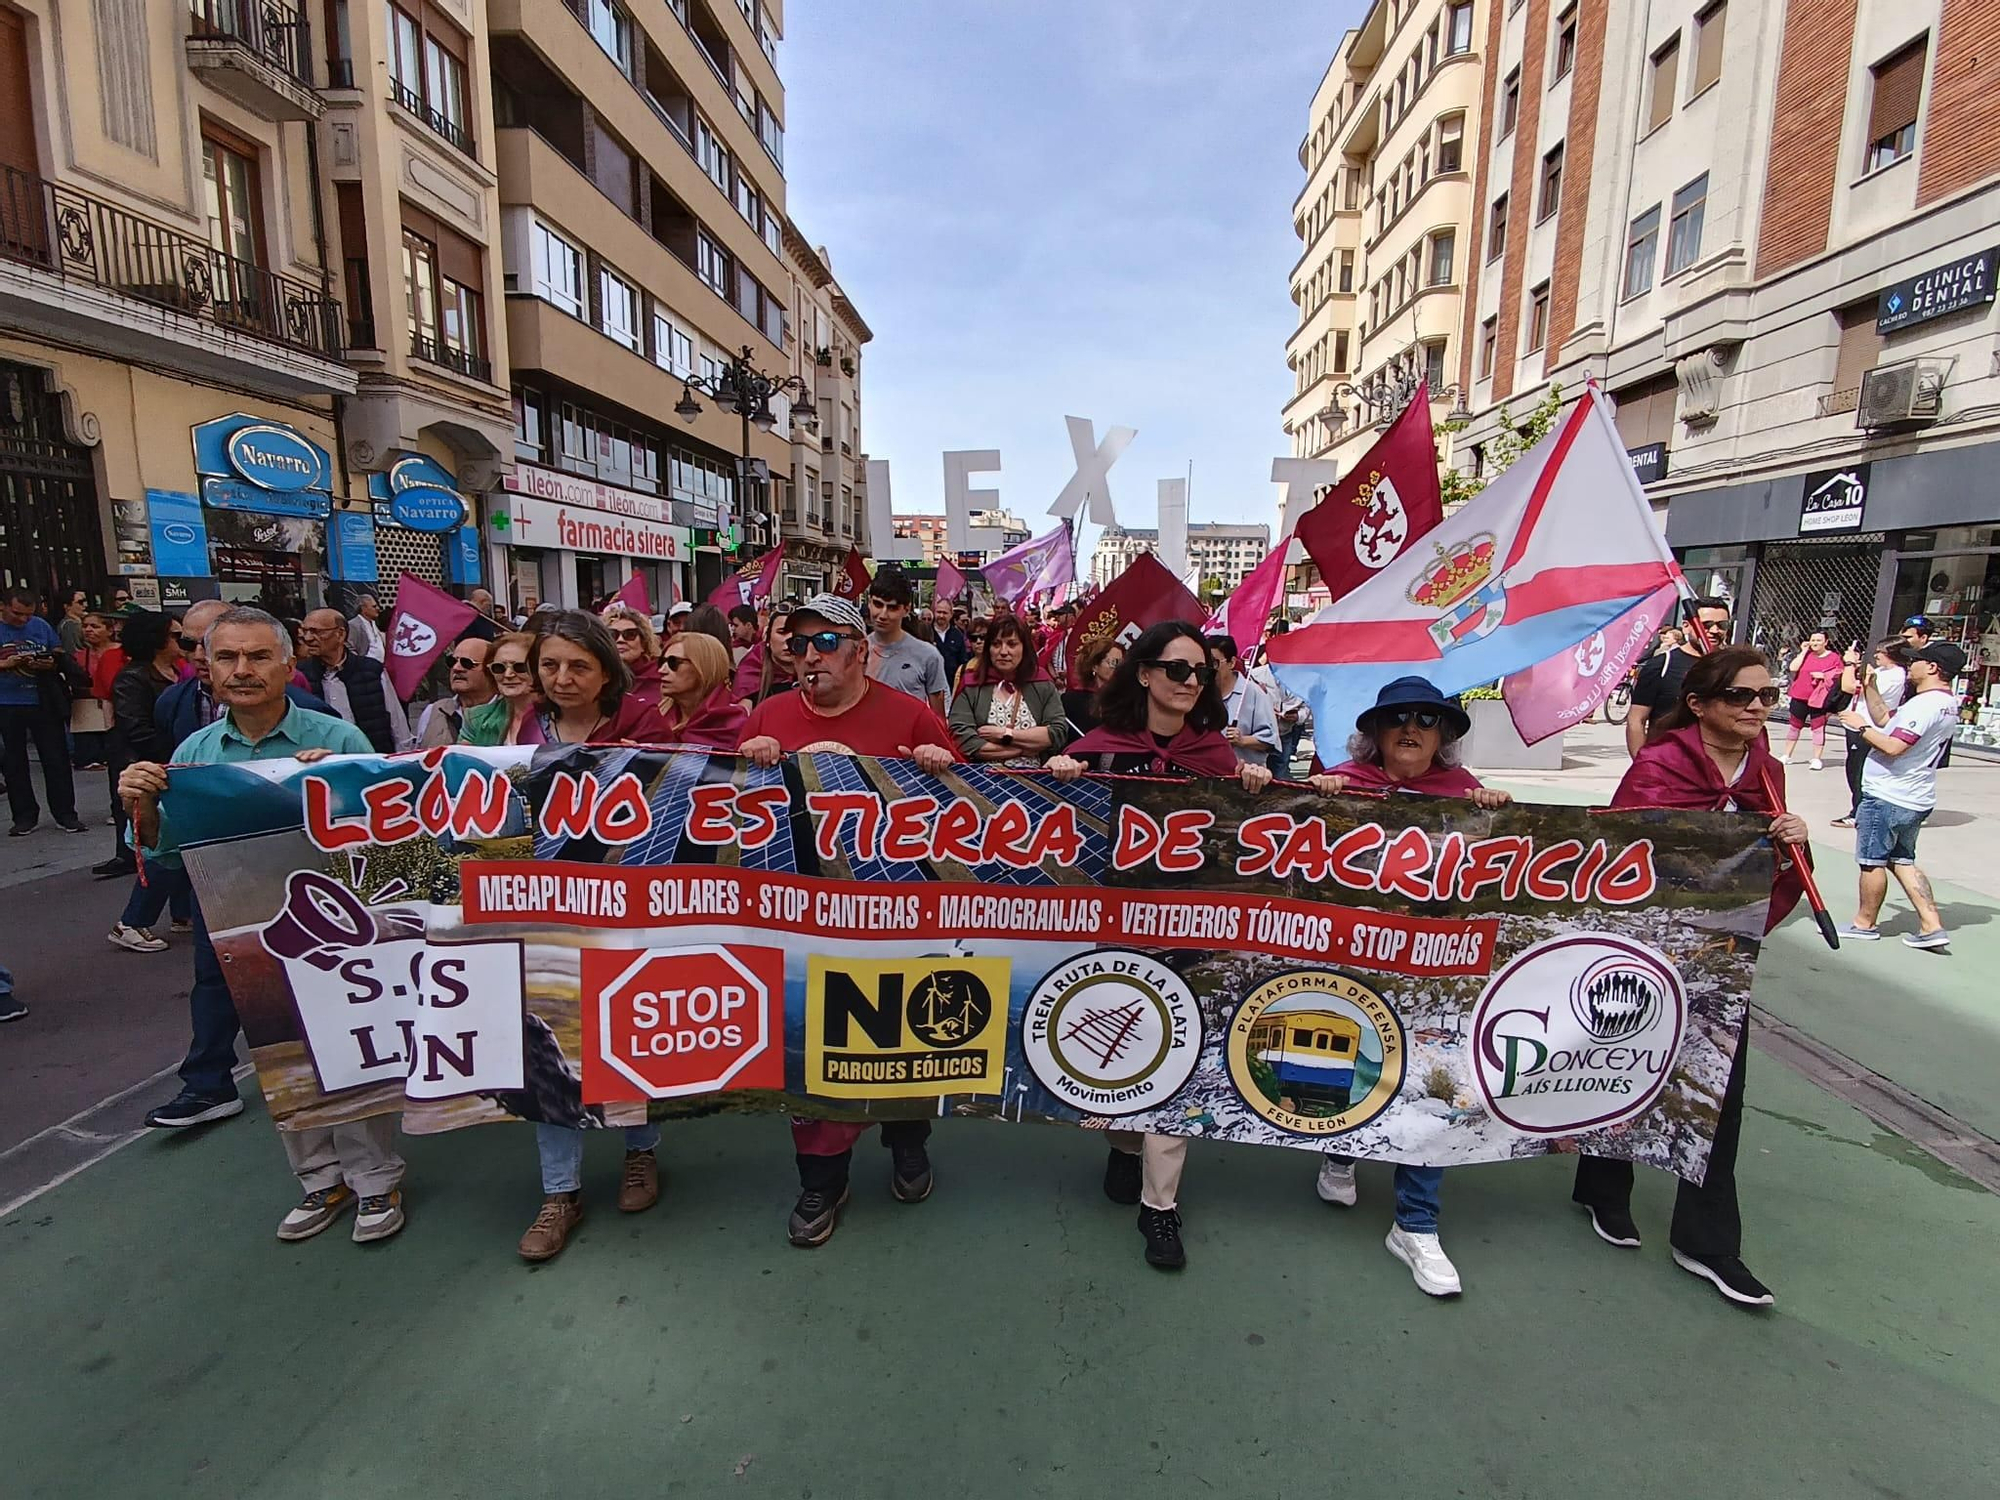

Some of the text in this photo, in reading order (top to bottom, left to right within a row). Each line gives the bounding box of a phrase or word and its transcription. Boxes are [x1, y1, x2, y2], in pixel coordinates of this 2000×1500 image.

[1912, 275, 1983, 311] DENTAL
[1914, 258, 1985, 295] CLÍNICA
[241, 443, 312, 474] Navarro
[398, 505, 458, 520] Navarro
[1805, 484, 1864, 512] La Casa 10
[557, 508, 676, 558] farmacia sirera
[165, 588, 188, 598] SMH
[302, 746, 1656, 905] LEÓN NO ES TIERRA DE SACRIFICIO
[479, 874, 1484, 968] MEGAPLANTAS SOLARES STOP CANTERAS MACROGRANJAS VERTEDEROS TÓXICOS STOP BIOGÁS
[631, 985, 746, 1030] STOP
[1032, 960, 1187, 1049] TREN RUTA DE LA PLATA
[1237, 977, 1396, 1054] PLATAFORMA DEFENSA
[630, 1026, 743, 1057] LODOS
[1481, 1005, 1668, 1073] CONCEYU
[826, 1054, 983, 1081] PARQUES EÓLICOS
[1056, 1075, 1154, 1103] Movimiento
[1553, 1076, 1634, 1095] LLIONÉS
[1266, 1107, 1302, 1128] FEVE
